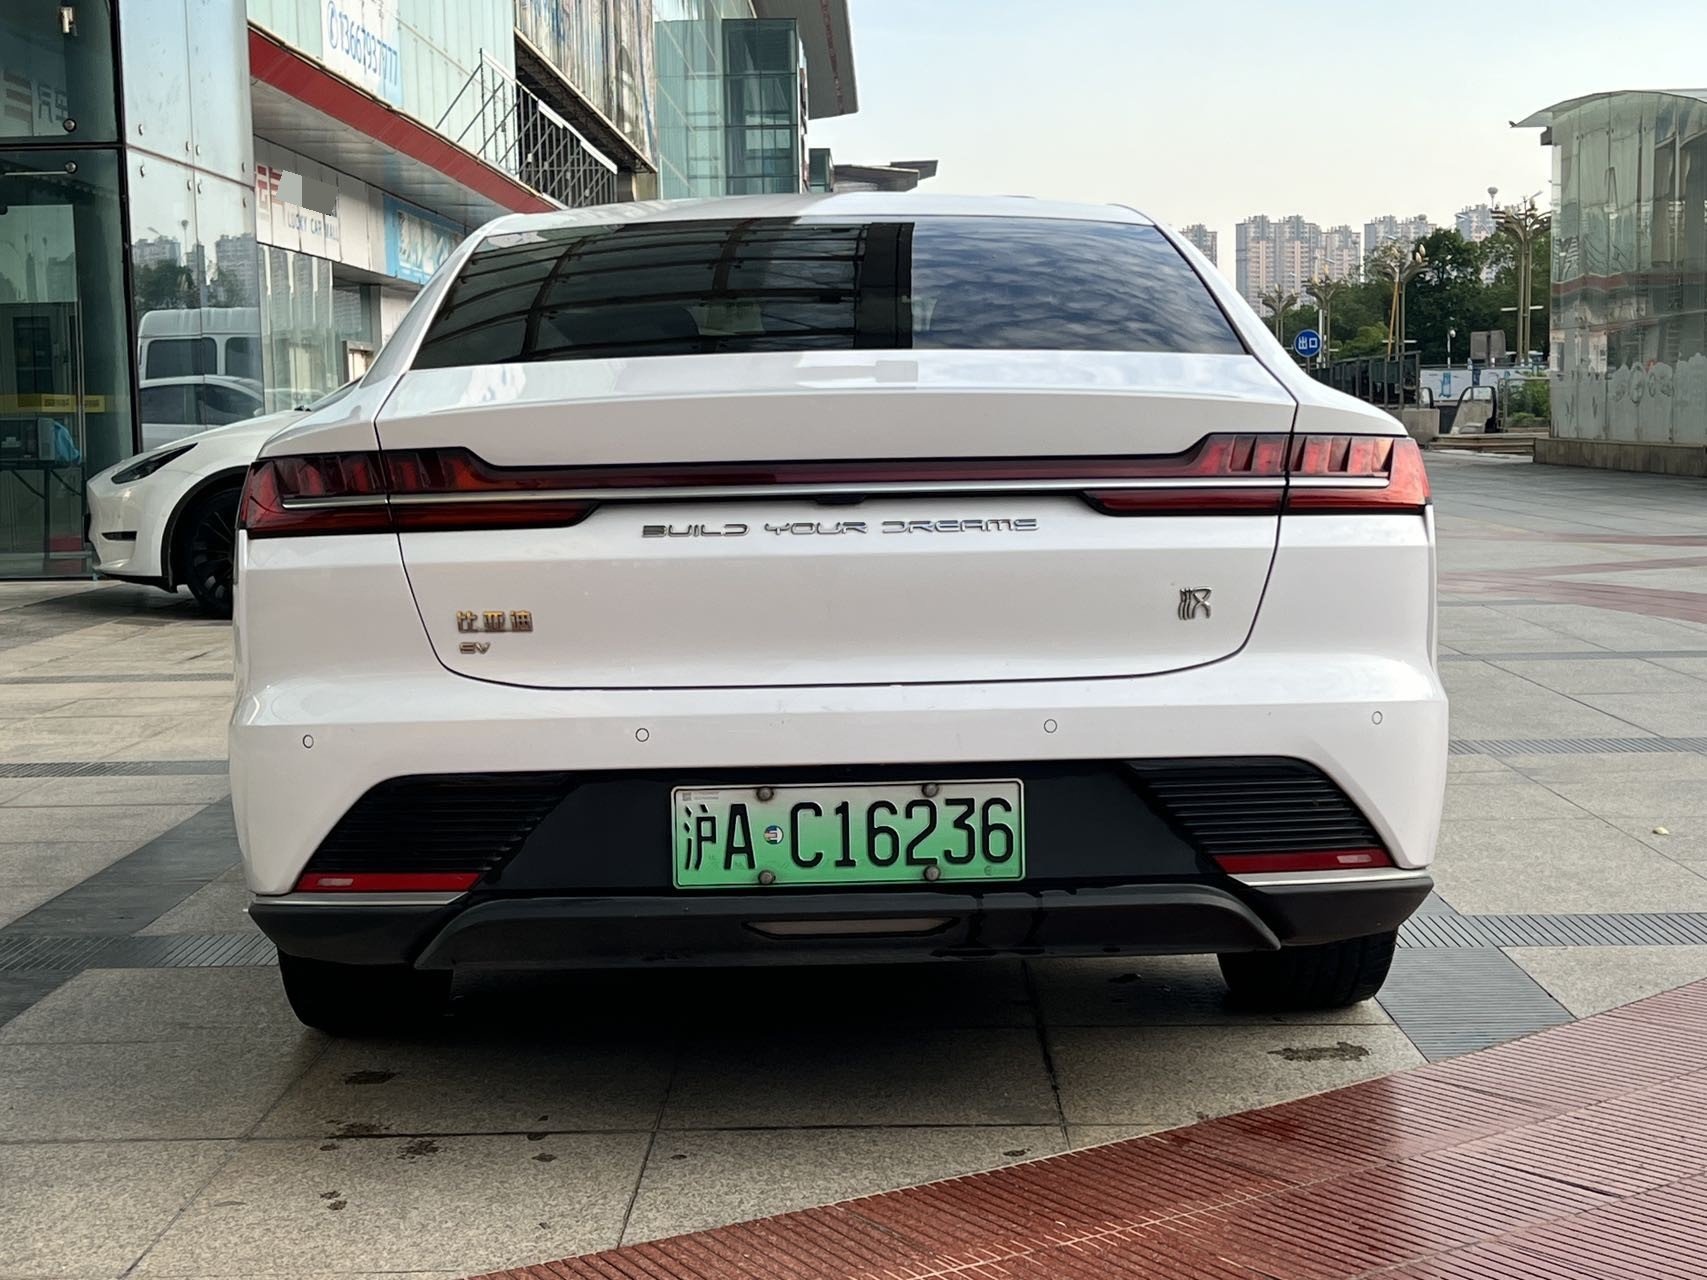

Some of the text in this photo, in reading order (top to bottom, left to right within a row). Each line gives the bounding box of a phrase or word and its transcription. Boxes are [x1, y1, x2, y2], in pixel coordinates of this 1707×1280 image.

[1298, 336, 1318, 350] 出口
[641, 518, 1040, 538] BUILD YOUR DREAMS
[456, 610, 534, 633] 比亚迪
[459, 641, 491, 654] EV
[790, 797, 1015, 869] C16236
